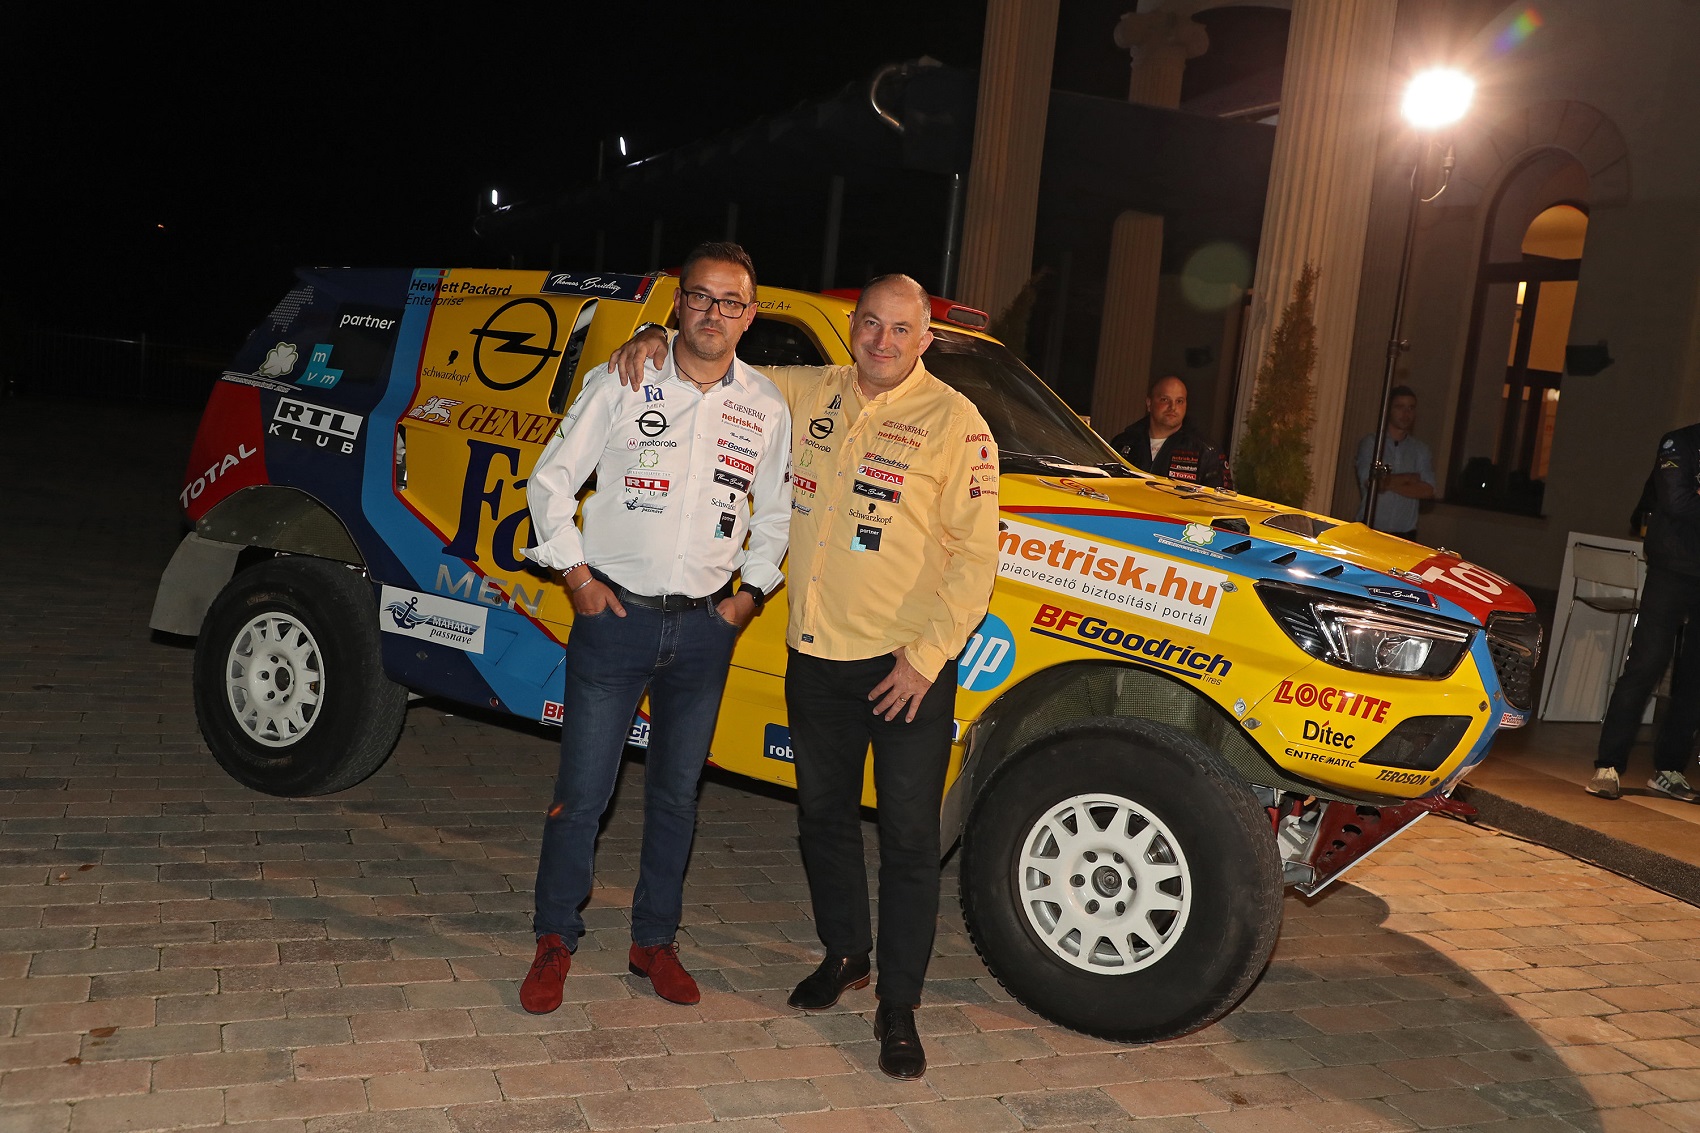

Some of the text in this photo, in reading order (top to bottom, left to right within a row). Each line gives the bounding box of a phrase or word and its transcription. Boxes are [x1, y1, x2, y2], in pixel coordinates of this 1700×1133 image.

[410, 279, 512, 297] Hewlett Packard
[405, 294, 464, 306] Enterprise
[339, 313, 395, 331] partner
[421, 366, 472, 386] Schwarzkopf
[643, 384, 665, 402] Fa
[277, 402, 356, 436] RTL
[733, 403, 766, 422] GENERALI
[721, 412, 763, 433] netrisk.hu
[893, 422, 929, 438] GENERALI
[268, 422, 354, 455] KLUB
[639, 439, 677, 448] motorola
[877, 430, 922, 448] netrisk.hu
[726, 457, 754, 475] TOTAL
[864, 451, 911, 471] BFGoodrich
[178, 443, 257, 509] TOTAL
[626, 477, 669, 490] RTL
[793, 476, 817, 491] RTL
[868, 468, 903, 486] TOTAL
[848, 508, 893, 525] Schwarzkopf
[998, 530, 1219, 609] netrisk.hu
[434, 563, 545, 616] MEN
[1421, 561, 1511, 604] TOT
[1001, 561, 1208, 627] piacvezető biztosítási portál
[431, 615, 475, 635] MAHART
[429, 627, 472, 645] passnave
[1033, 603, 1233, 678] BFGoodrich
[1201, 671, 1223, 686] Tires
[1273, 680, 1393, 724] LOCTITE
[1375, 769, 1431, 786] TEROSON
